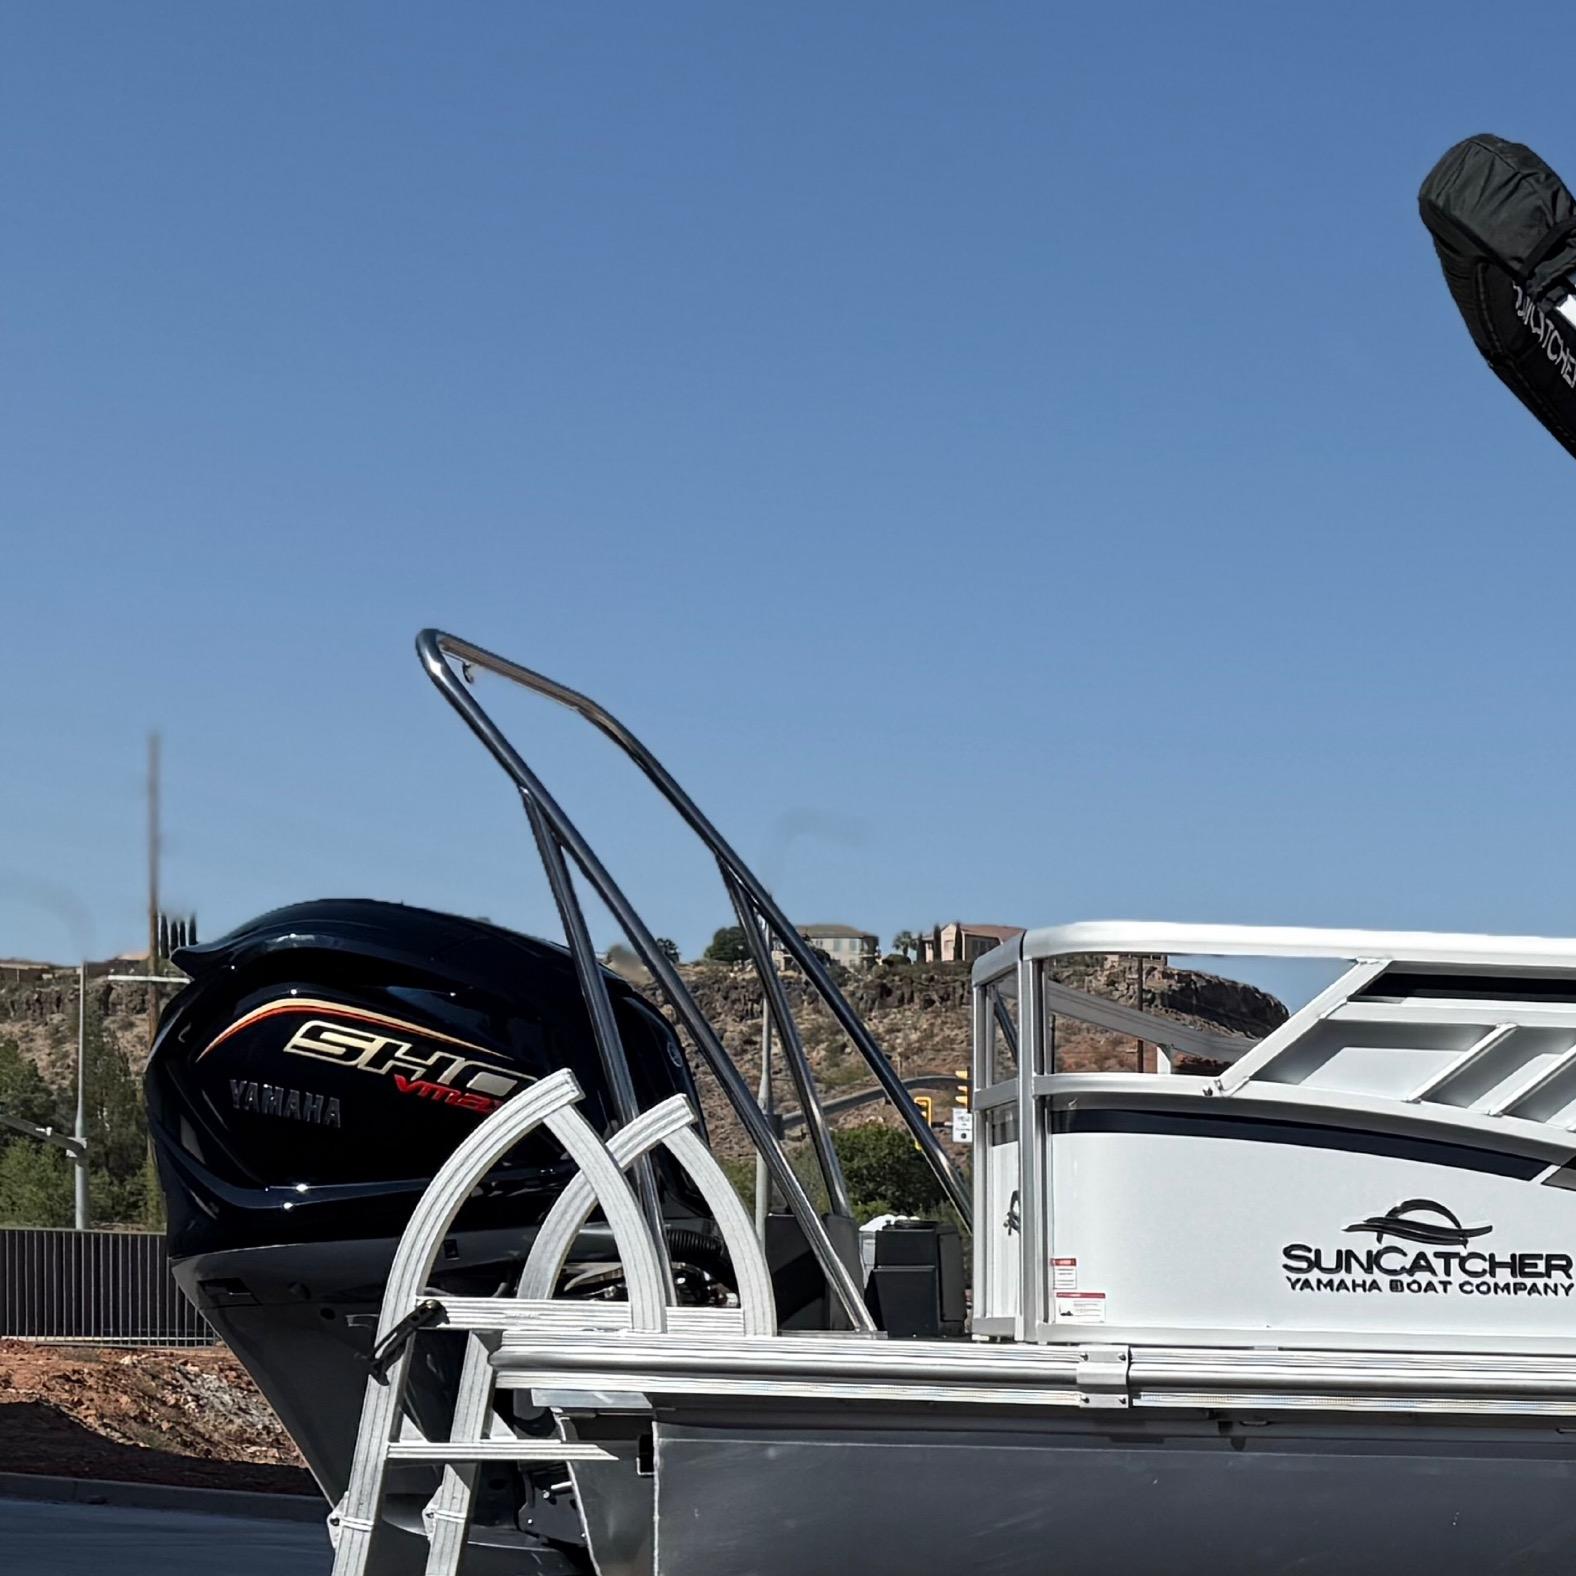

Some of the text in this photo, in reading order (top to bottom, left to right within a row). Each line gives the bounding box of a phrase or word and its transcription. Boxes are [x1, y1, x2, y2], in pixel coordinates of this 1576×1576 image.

[283, 1020, 538, 1096] SHO
[229, 1079, 342, 1128] YAMAHA
[1286, 1276, 1575, 1297] YAMAHA BOAT COMPANY
